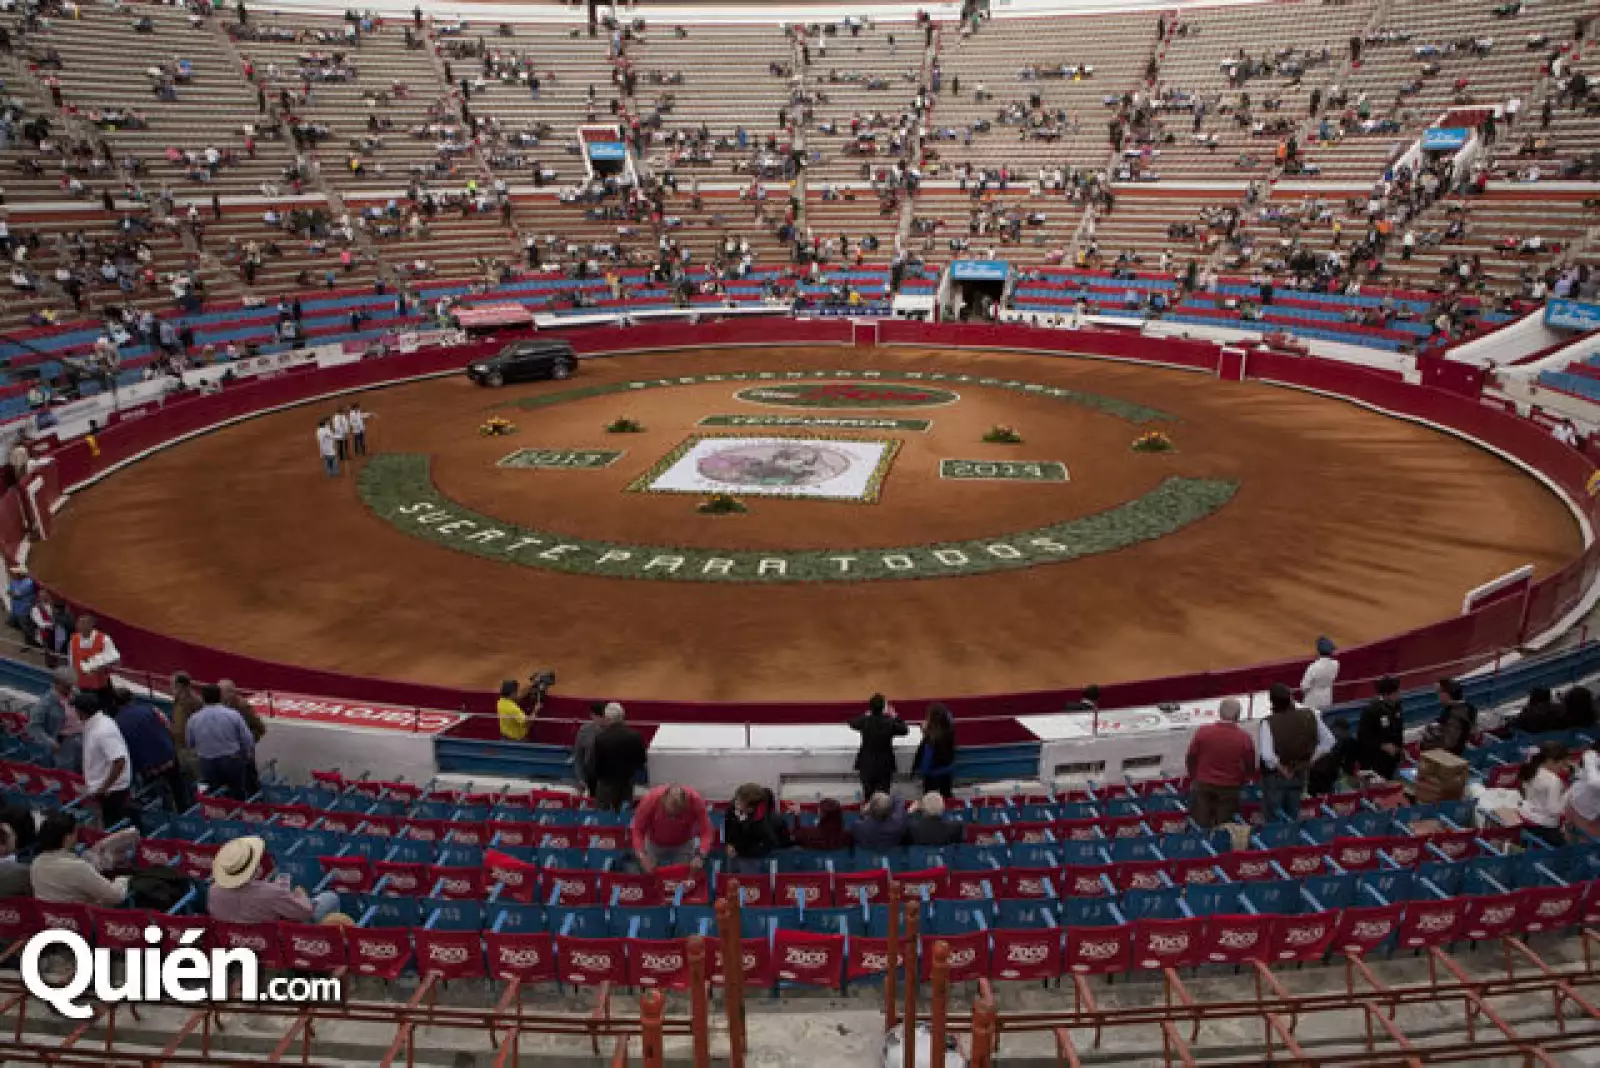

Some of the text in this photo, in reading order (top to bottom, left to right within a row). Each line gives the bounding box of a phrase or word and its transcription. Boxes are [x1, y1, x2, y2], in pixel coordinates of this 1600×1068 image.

[399, 502, 1068, 576] SUERTE PARA TODOS
[946, 948, 976, 967] oco
